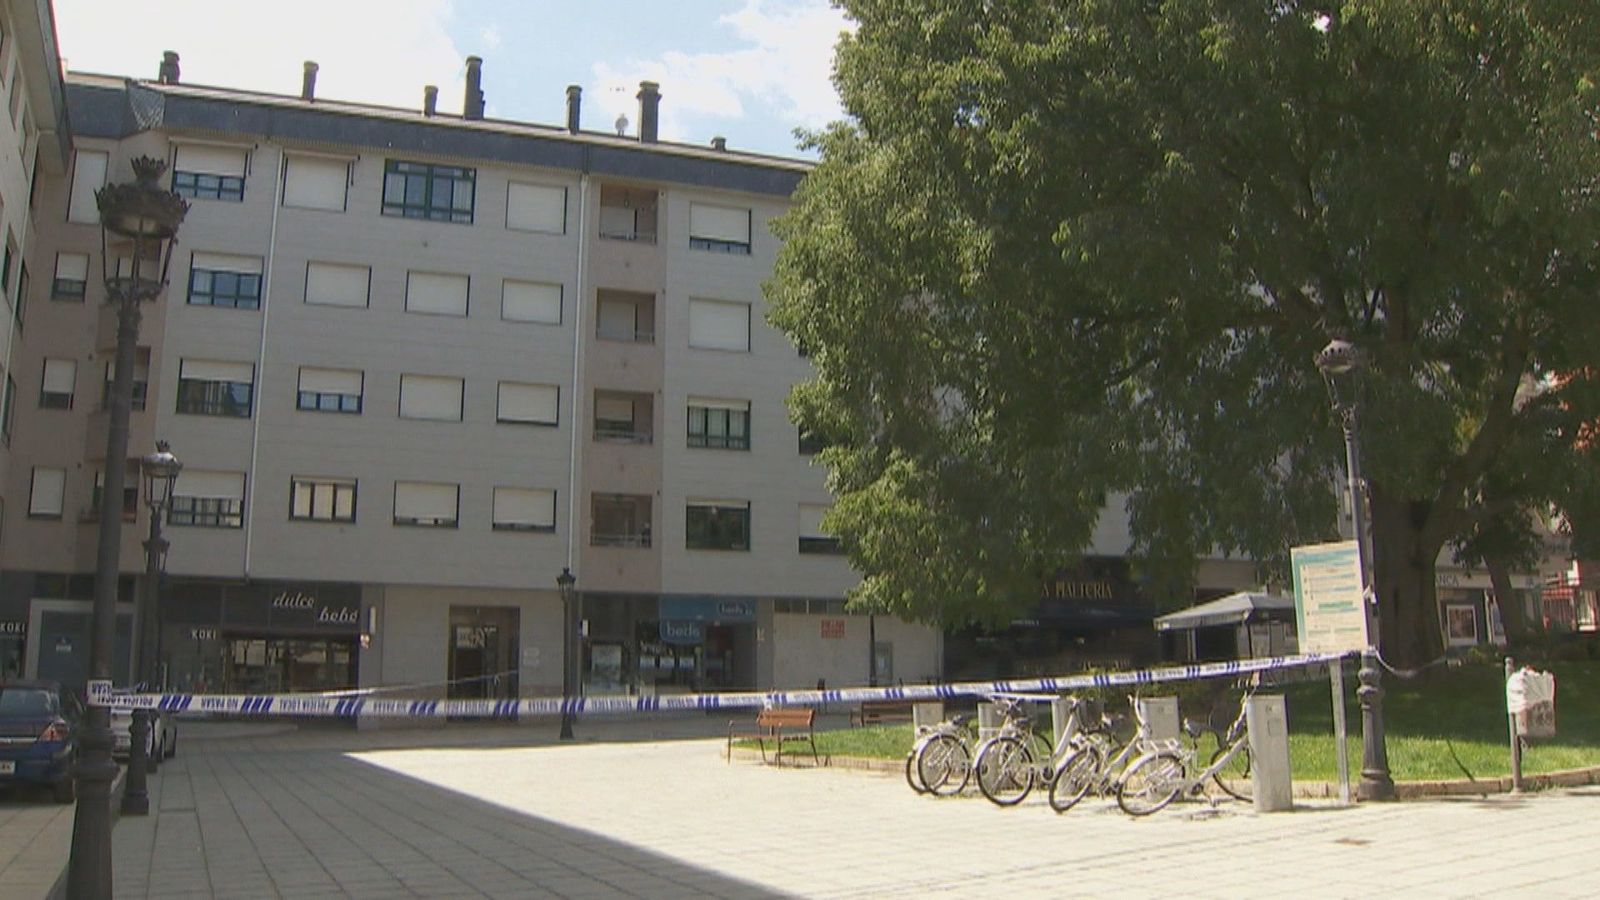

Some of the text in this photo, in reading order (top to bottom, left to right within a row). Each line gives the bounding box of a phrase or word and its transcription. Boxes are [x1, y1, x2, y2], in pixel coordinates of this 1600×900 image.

[273, 591, 316, 609] dulce
[0, 621, 26, 633] KOKI
[191, 628, 217, 641] KOKI
